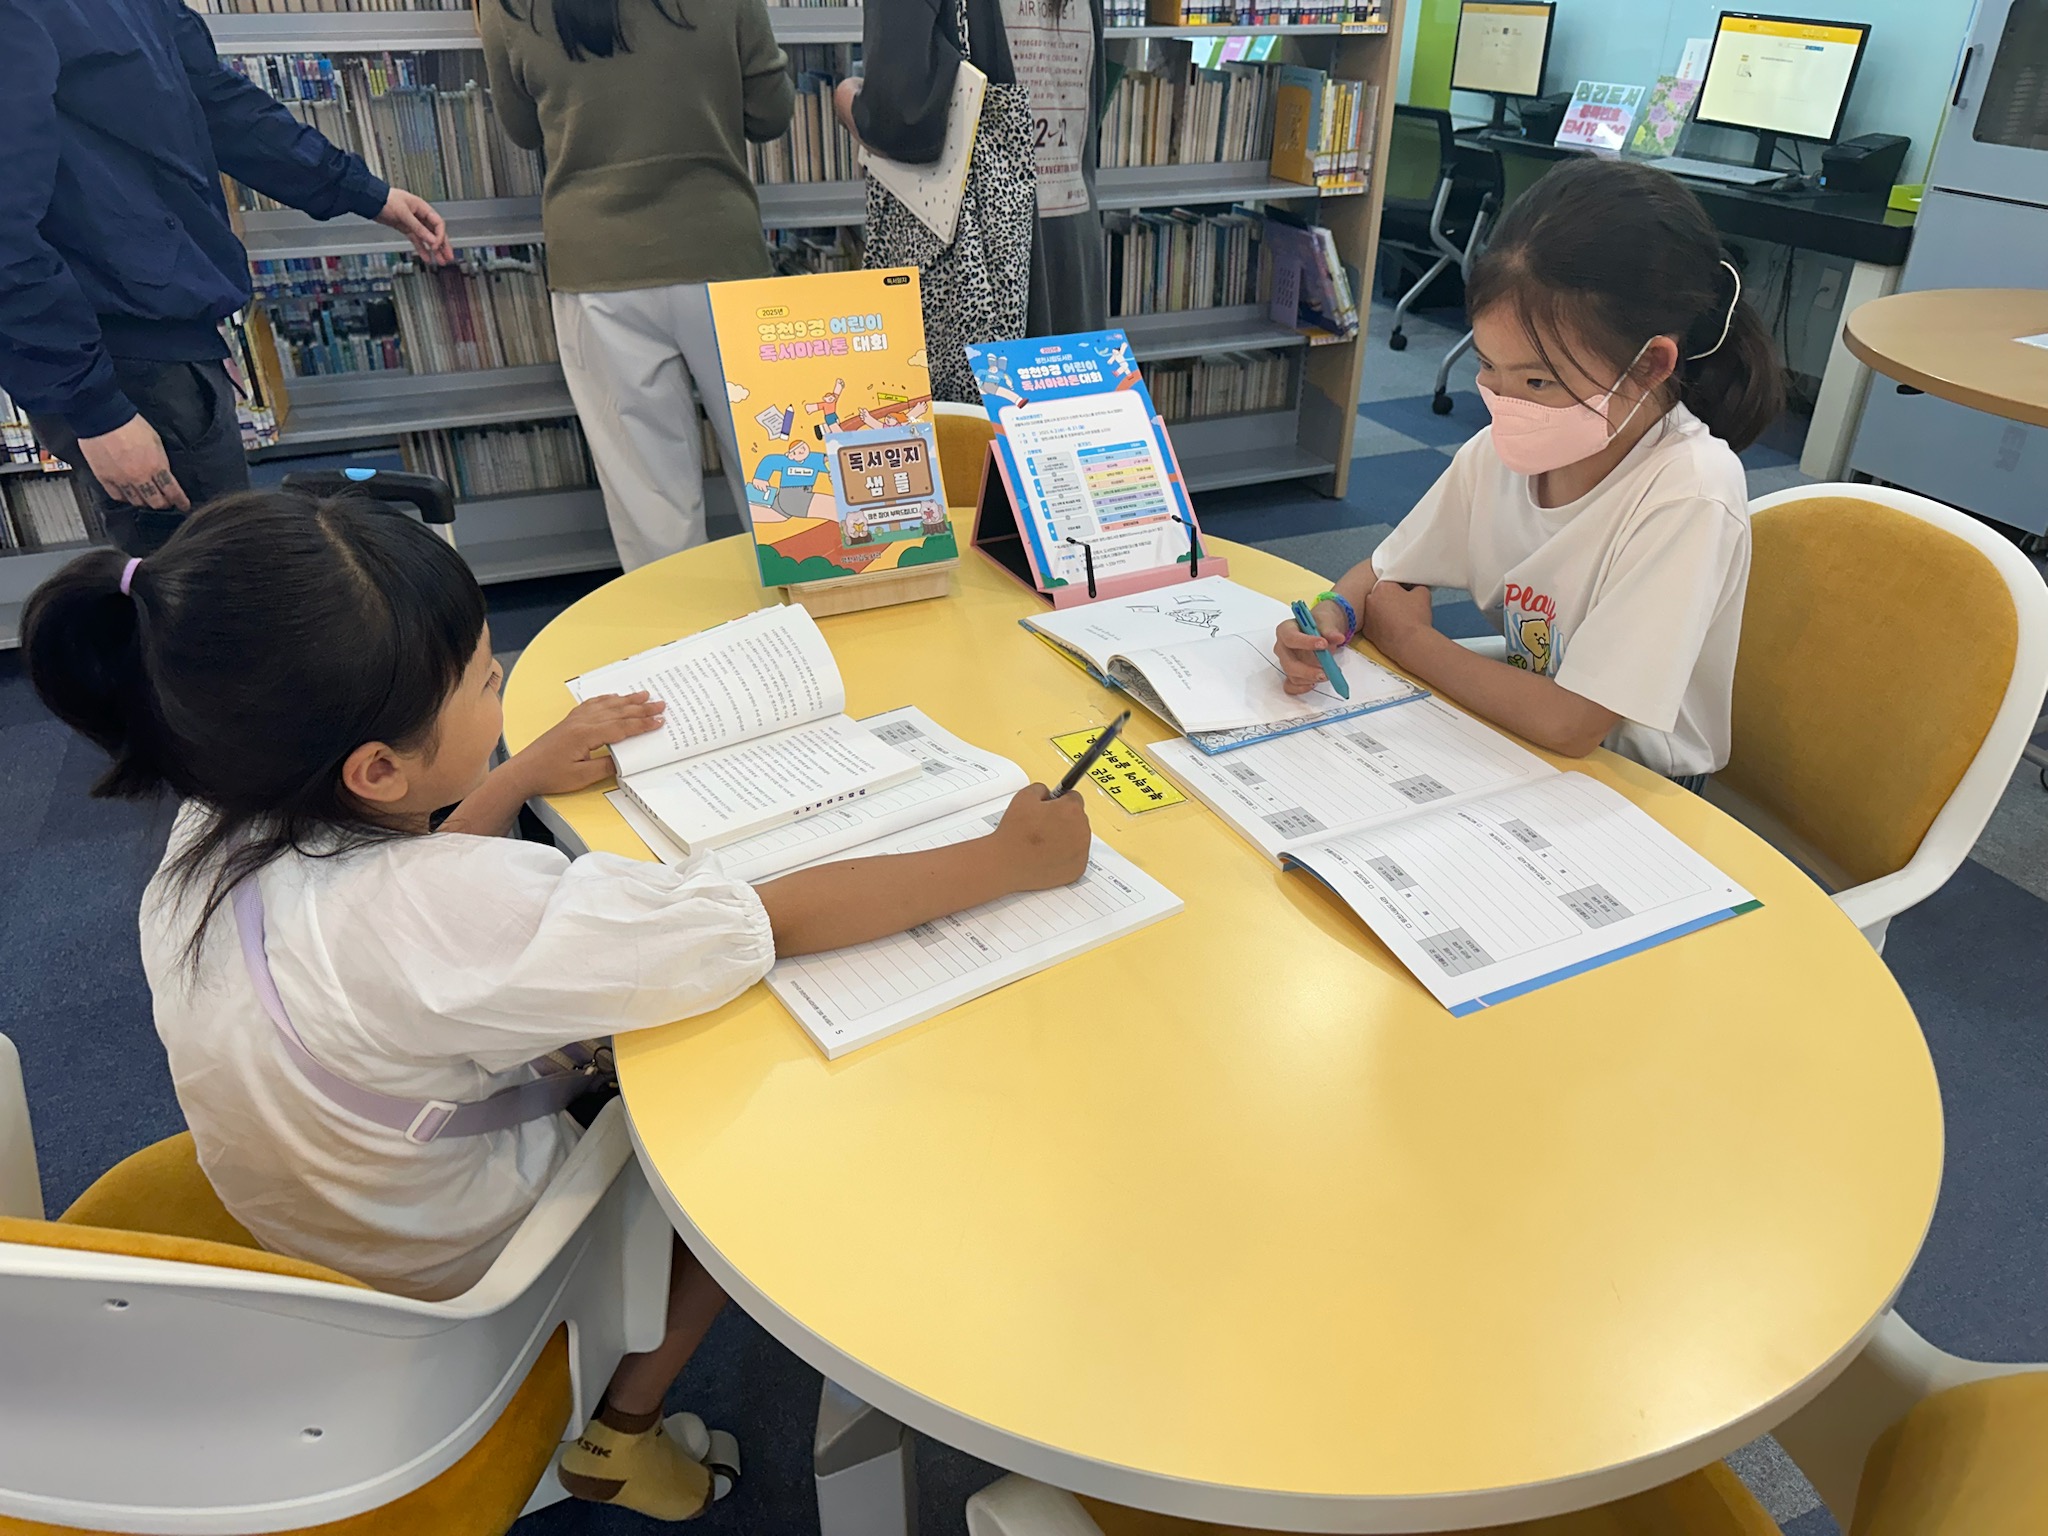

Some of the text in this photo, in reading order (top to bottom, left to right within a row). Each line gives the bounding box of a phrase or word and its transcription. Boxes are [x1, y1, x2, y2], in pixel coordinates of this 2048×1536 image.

[1018, 1, 1036, 17] AIR
[762, 308, 784, 317] 2025년
[758, 313, 883, 342] 영천9경 어린이
[759, 333, 889, 363] 독서마라톤 대회
[1017, 359, 1098, 380] 영천9경 어린이
[848, 446, 920, 473] 독서일지
[1505, 583, 1556, 623] Play
[1090, 768, 1117, 784] 읽은
[1123, 771, 1164, 801] 북트럭에
